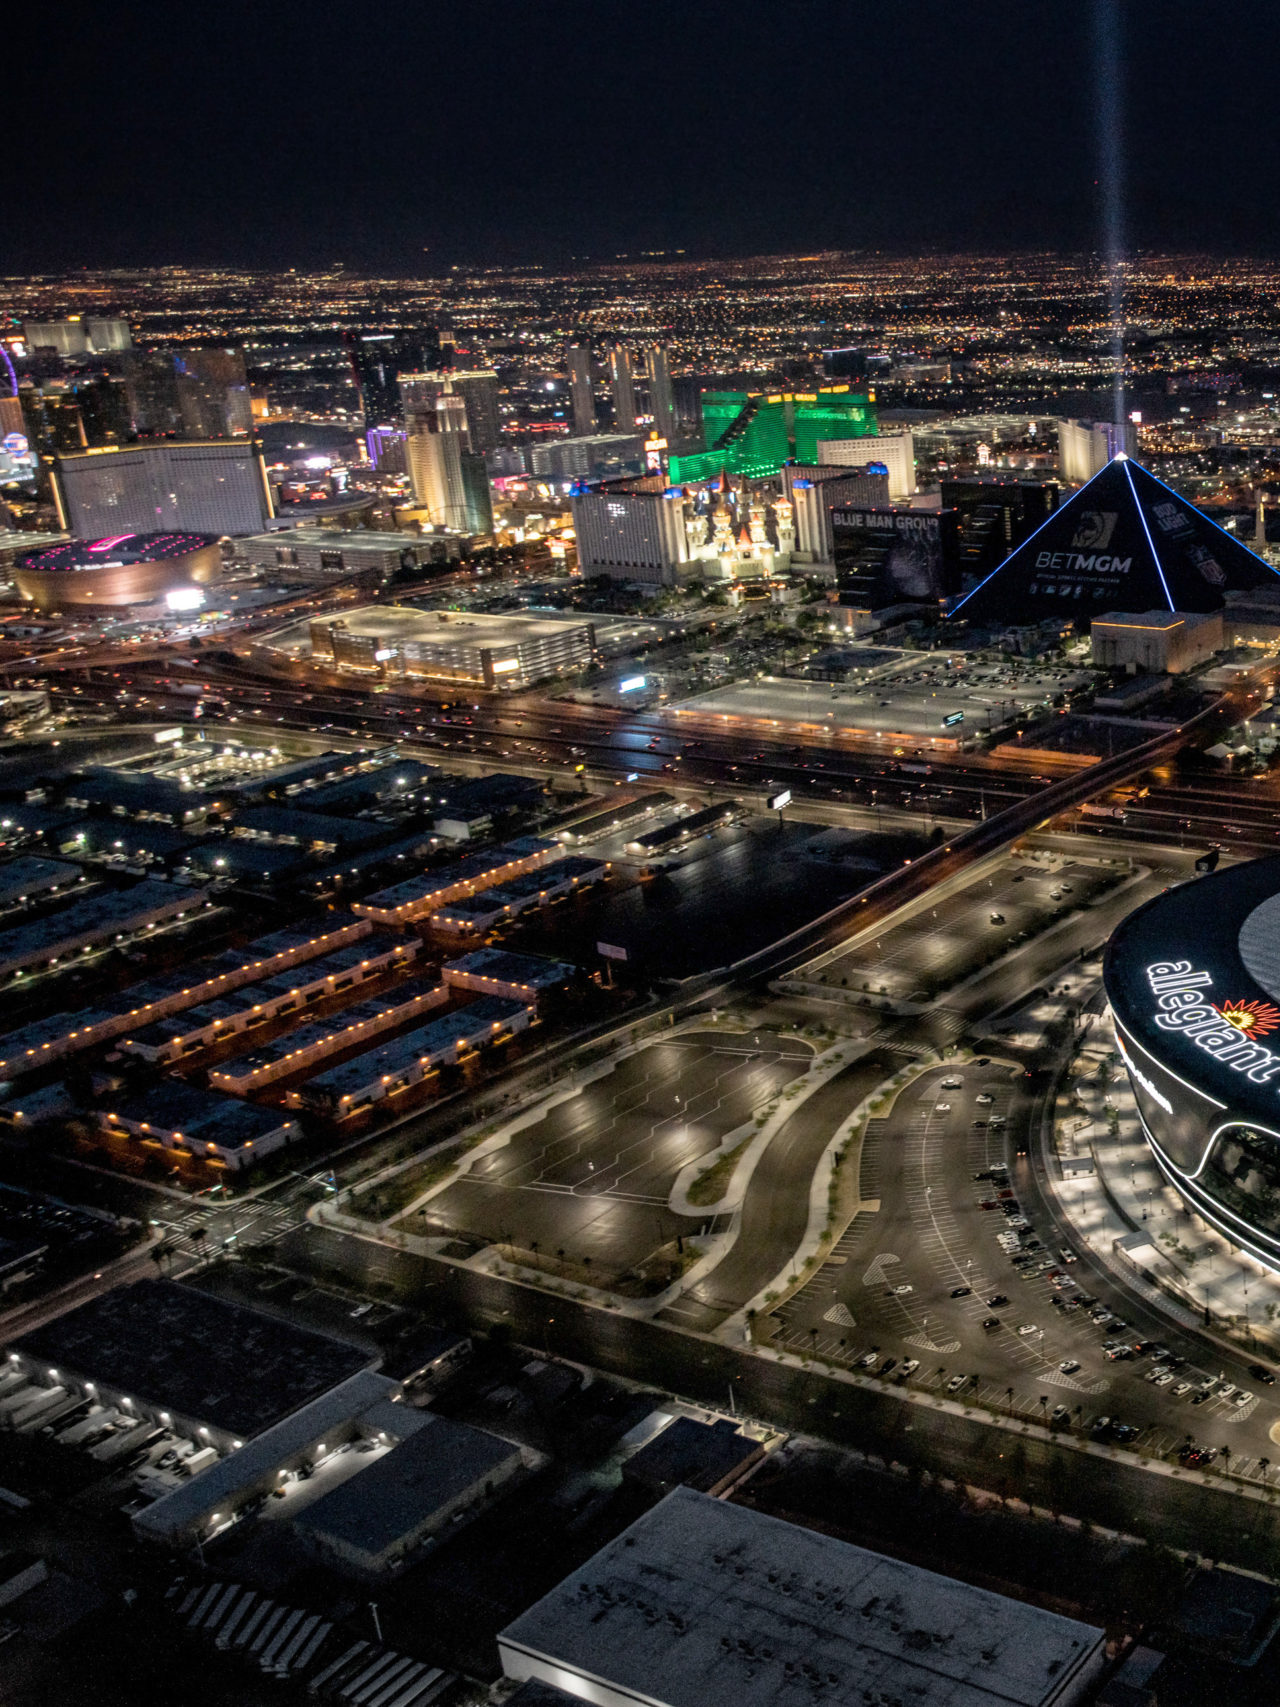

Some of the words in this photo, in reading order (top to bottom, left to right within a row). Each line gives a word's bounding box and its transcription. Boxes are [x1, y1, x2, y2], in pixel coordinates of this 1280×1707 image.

[833, 512, 863, 527] BLUE
[866, 514, 893, 529] MAN
[895, 516, 939, 531] GROUP
[1035, 551, 1133, 573] BETMGM
